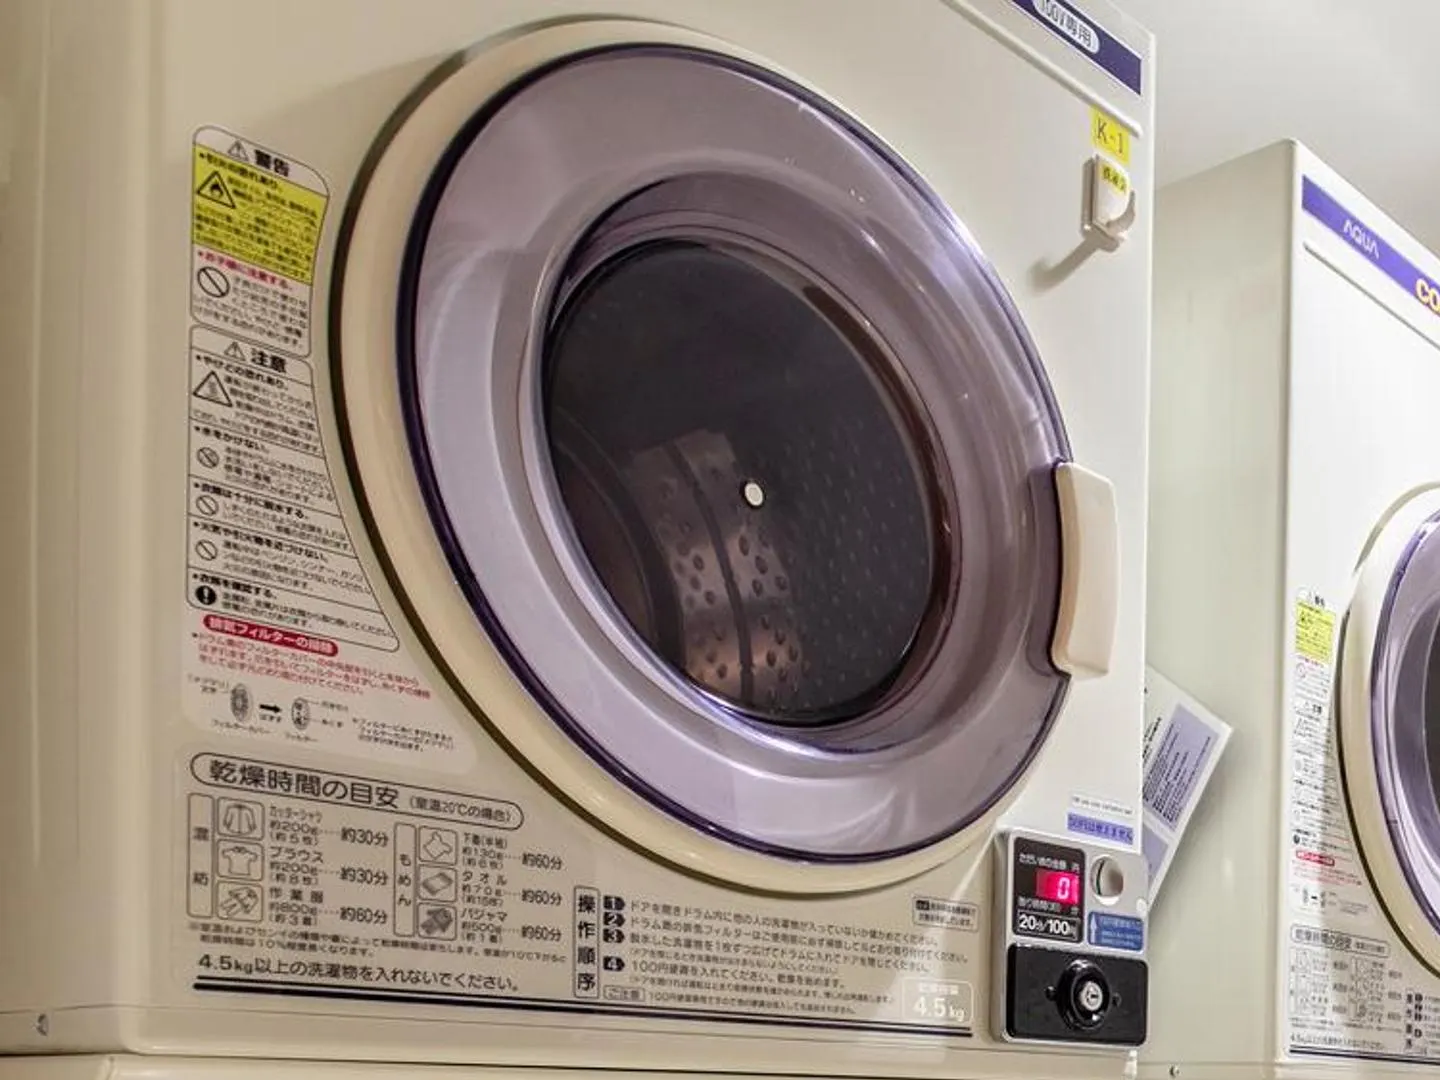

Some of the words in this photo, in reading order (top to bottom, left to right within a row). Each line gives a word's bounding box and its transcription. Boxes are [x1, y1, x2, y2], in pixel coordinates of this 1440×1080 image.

[250, 348, 287, 374] 注意
[209, 759, 399, 809] 乾燥時間の目安
[341, 826, 389, 847] 約30分
[269, 845, 324, 864] ブラウス
[340, 866, 389, 887] 約30分
[460, 907, 508, 922] パジャマ
[577, 894, 597, 991] 操作順序
[198, 953, 519, 992] 4.5kg以上の洗濯物を入れないでください。
